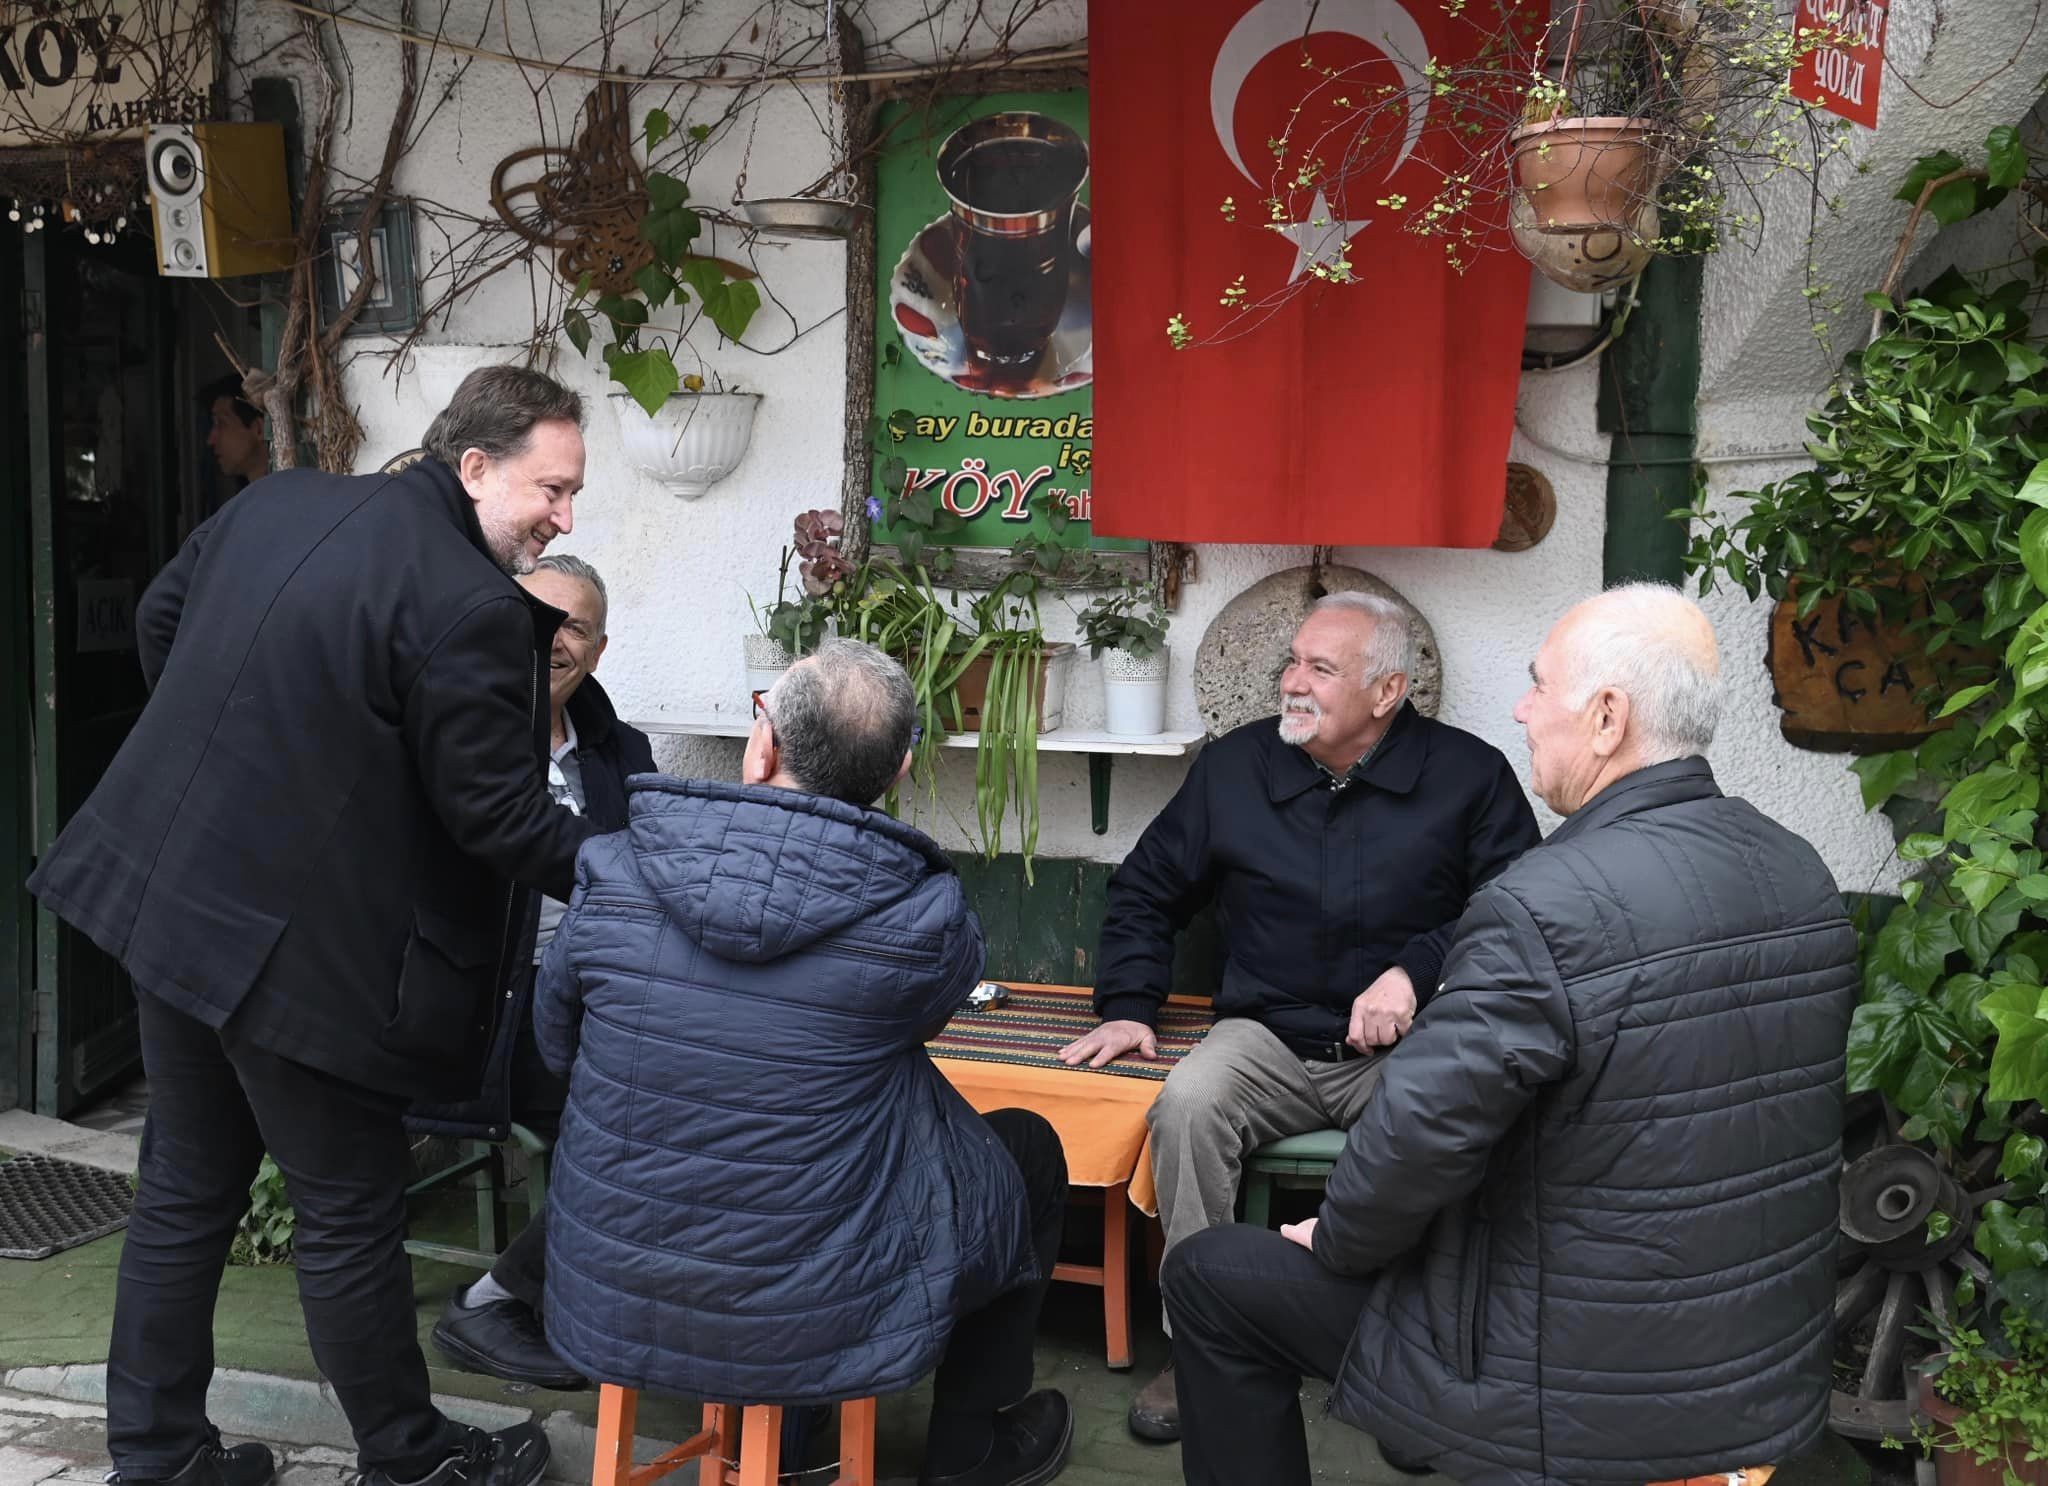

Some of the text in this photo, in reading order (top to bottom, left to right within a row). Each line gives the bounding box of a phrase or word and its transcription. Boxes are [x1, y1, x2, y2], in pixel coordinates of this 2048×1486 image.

[86, 87, 208, 131] KAHVESİ
[966, 411, 1092, 438] burada
[86, 596, 129, 640] AÇIK
